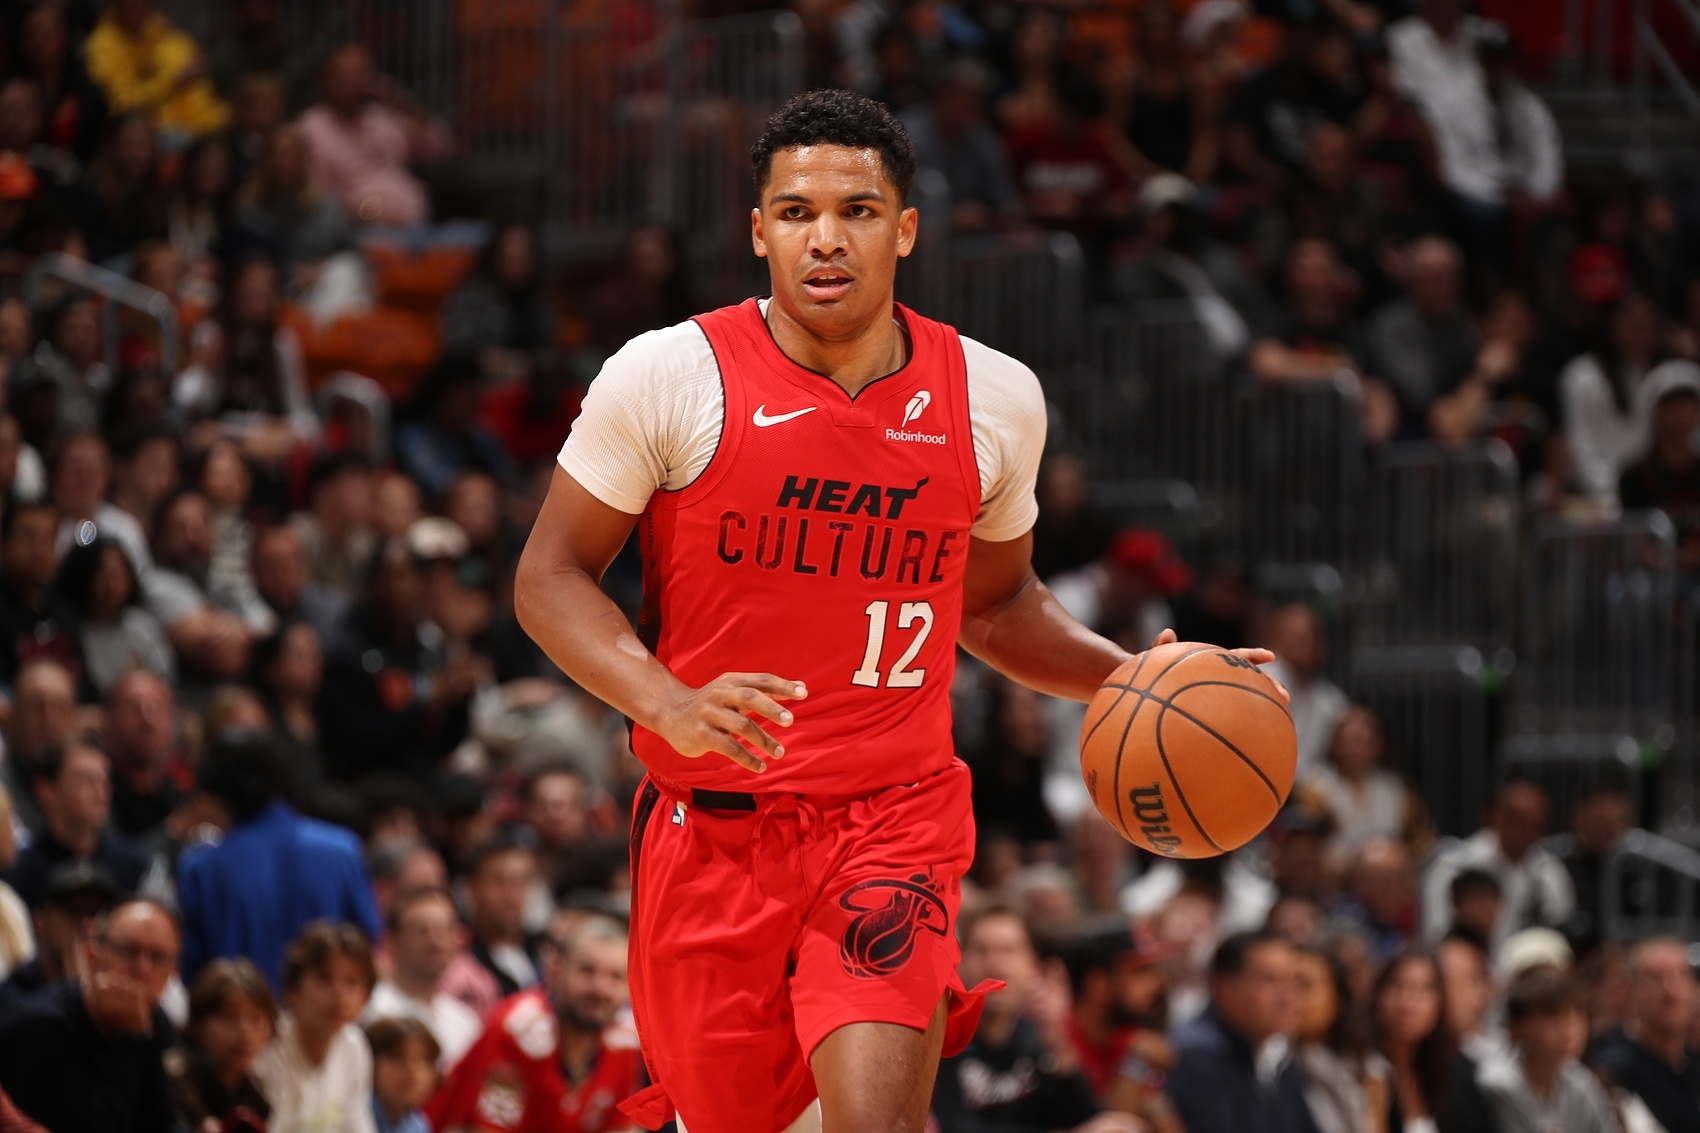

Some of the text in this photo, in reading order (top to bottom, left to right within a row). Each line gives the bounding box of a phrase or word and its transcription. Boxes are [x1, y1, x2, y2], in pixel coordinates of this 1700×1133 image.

[885, 428, 946, 445] Robinhood
[776, 475, 929, 520] HEAT
[717, 509, 957, 584] CULTURE
[851, 600, 934, 688] 12
